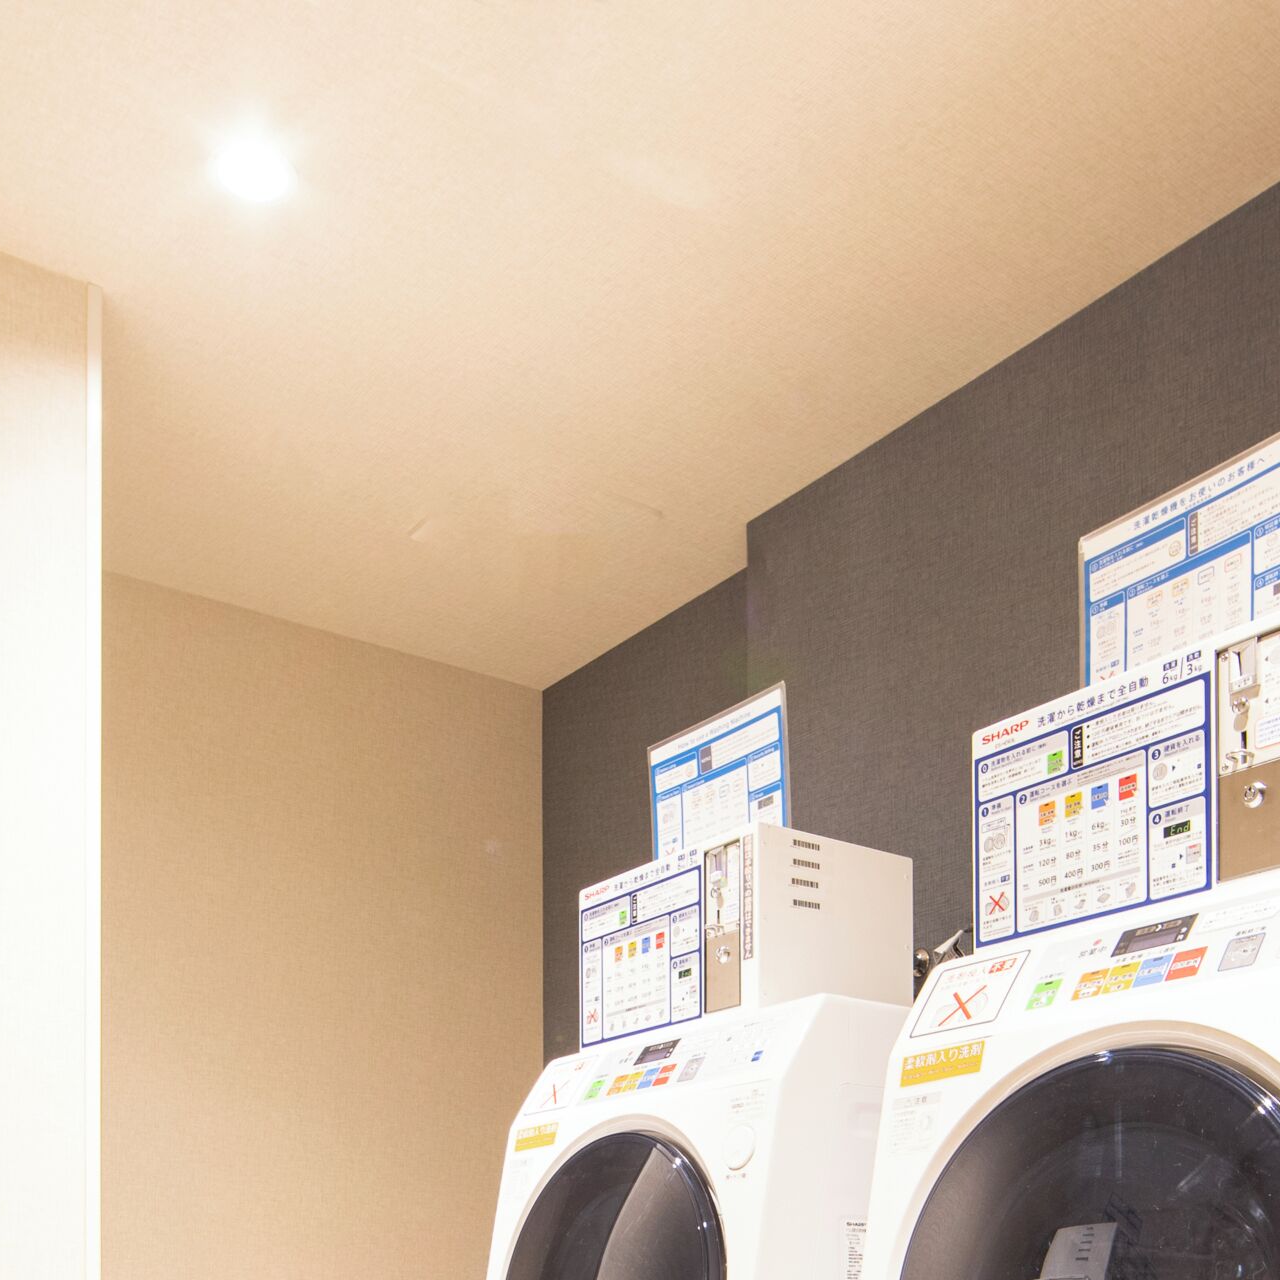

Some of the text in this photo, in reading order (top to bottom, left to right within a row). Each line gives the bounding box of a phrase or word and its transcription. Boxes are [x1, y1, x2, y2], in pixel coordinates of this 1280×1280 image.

[1037, 677, 1149, 728] 洗濯から乾燥まで全自動
[982, 720, 1029, 745] SHARP
[585, 885, 610, 901] SHARP
[902, 1041, 983, 1072] 柔軟剤入り洗剤
